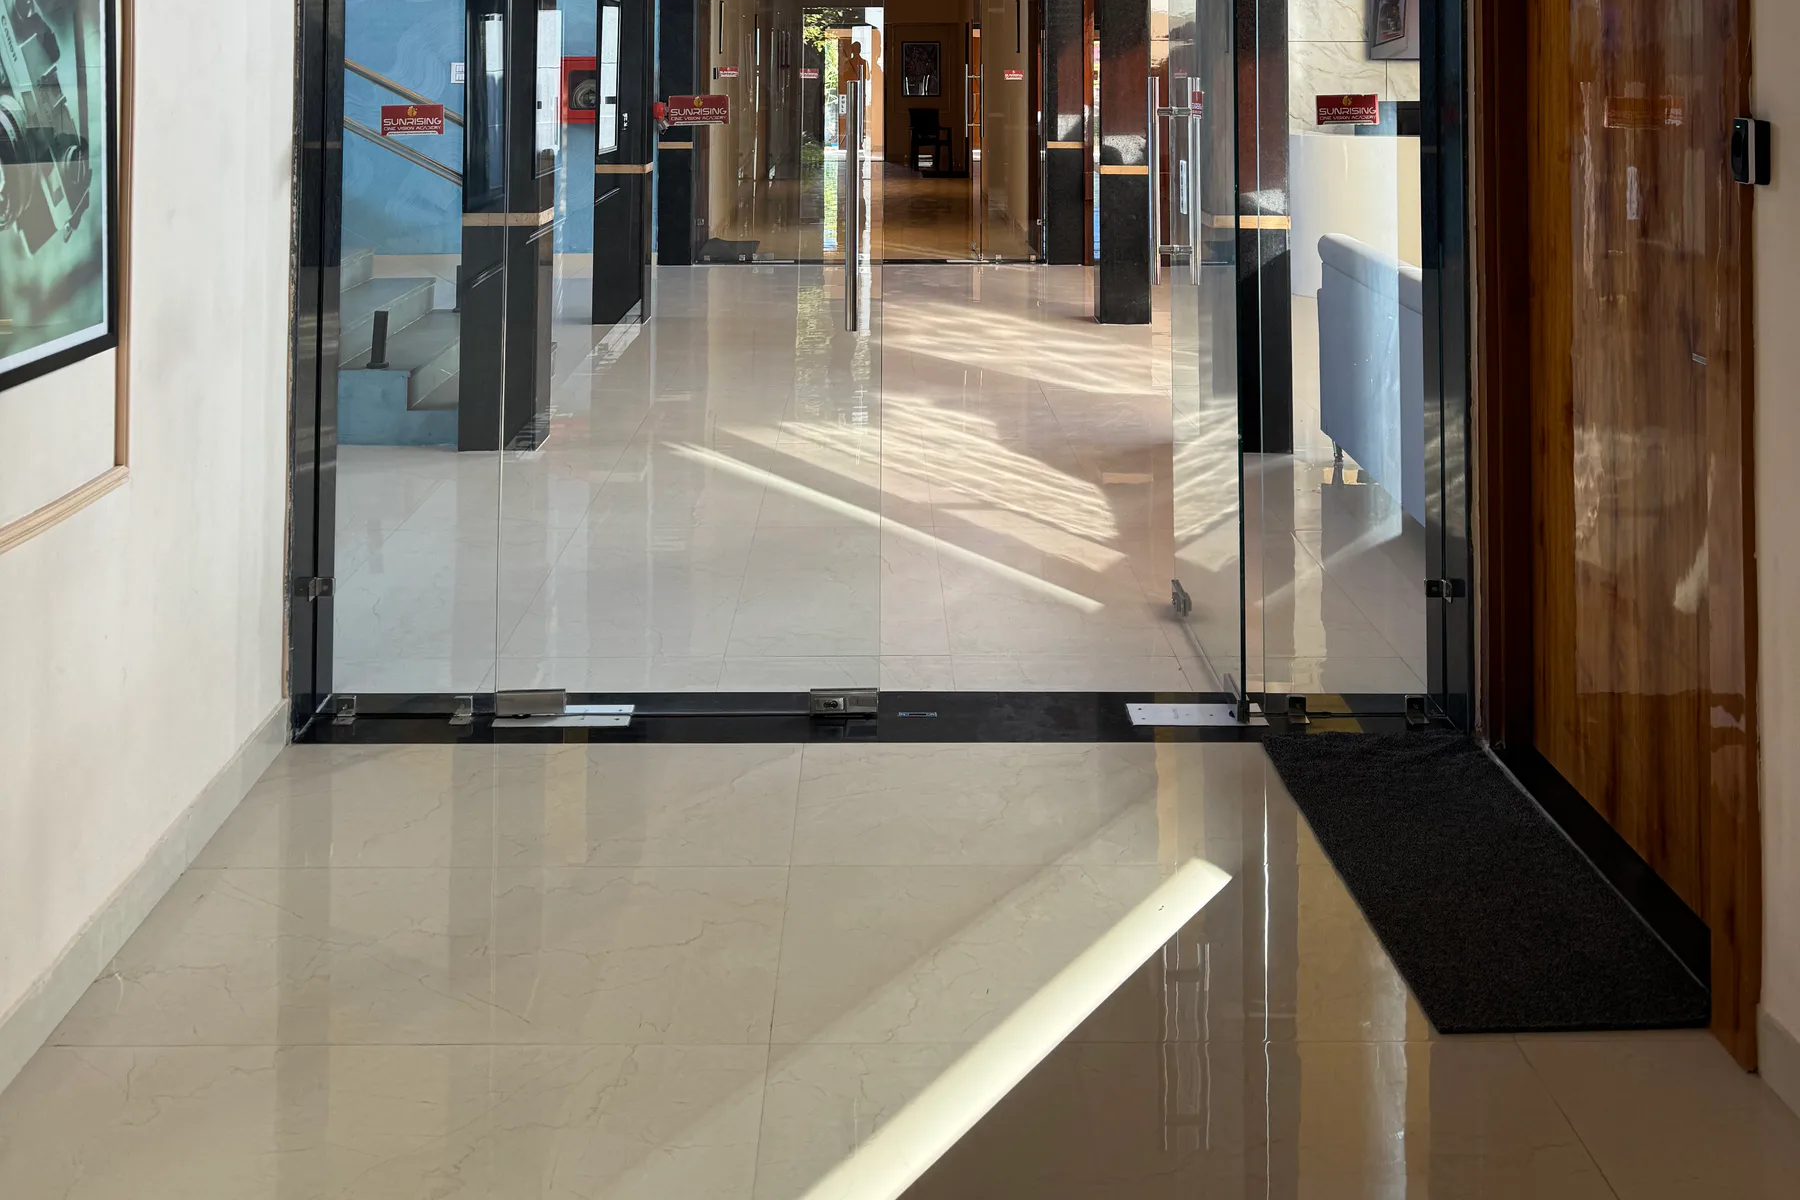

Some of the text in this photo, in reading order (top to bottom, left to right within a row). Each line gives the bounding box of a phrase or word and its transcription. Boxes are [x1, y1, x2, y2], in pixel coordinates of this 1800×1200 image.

[670, 107, 727, 116] SUNRISING
[1319, 107, 1377, 115] SUNRISING
[383, 117, 442, 126] SUNRISING
